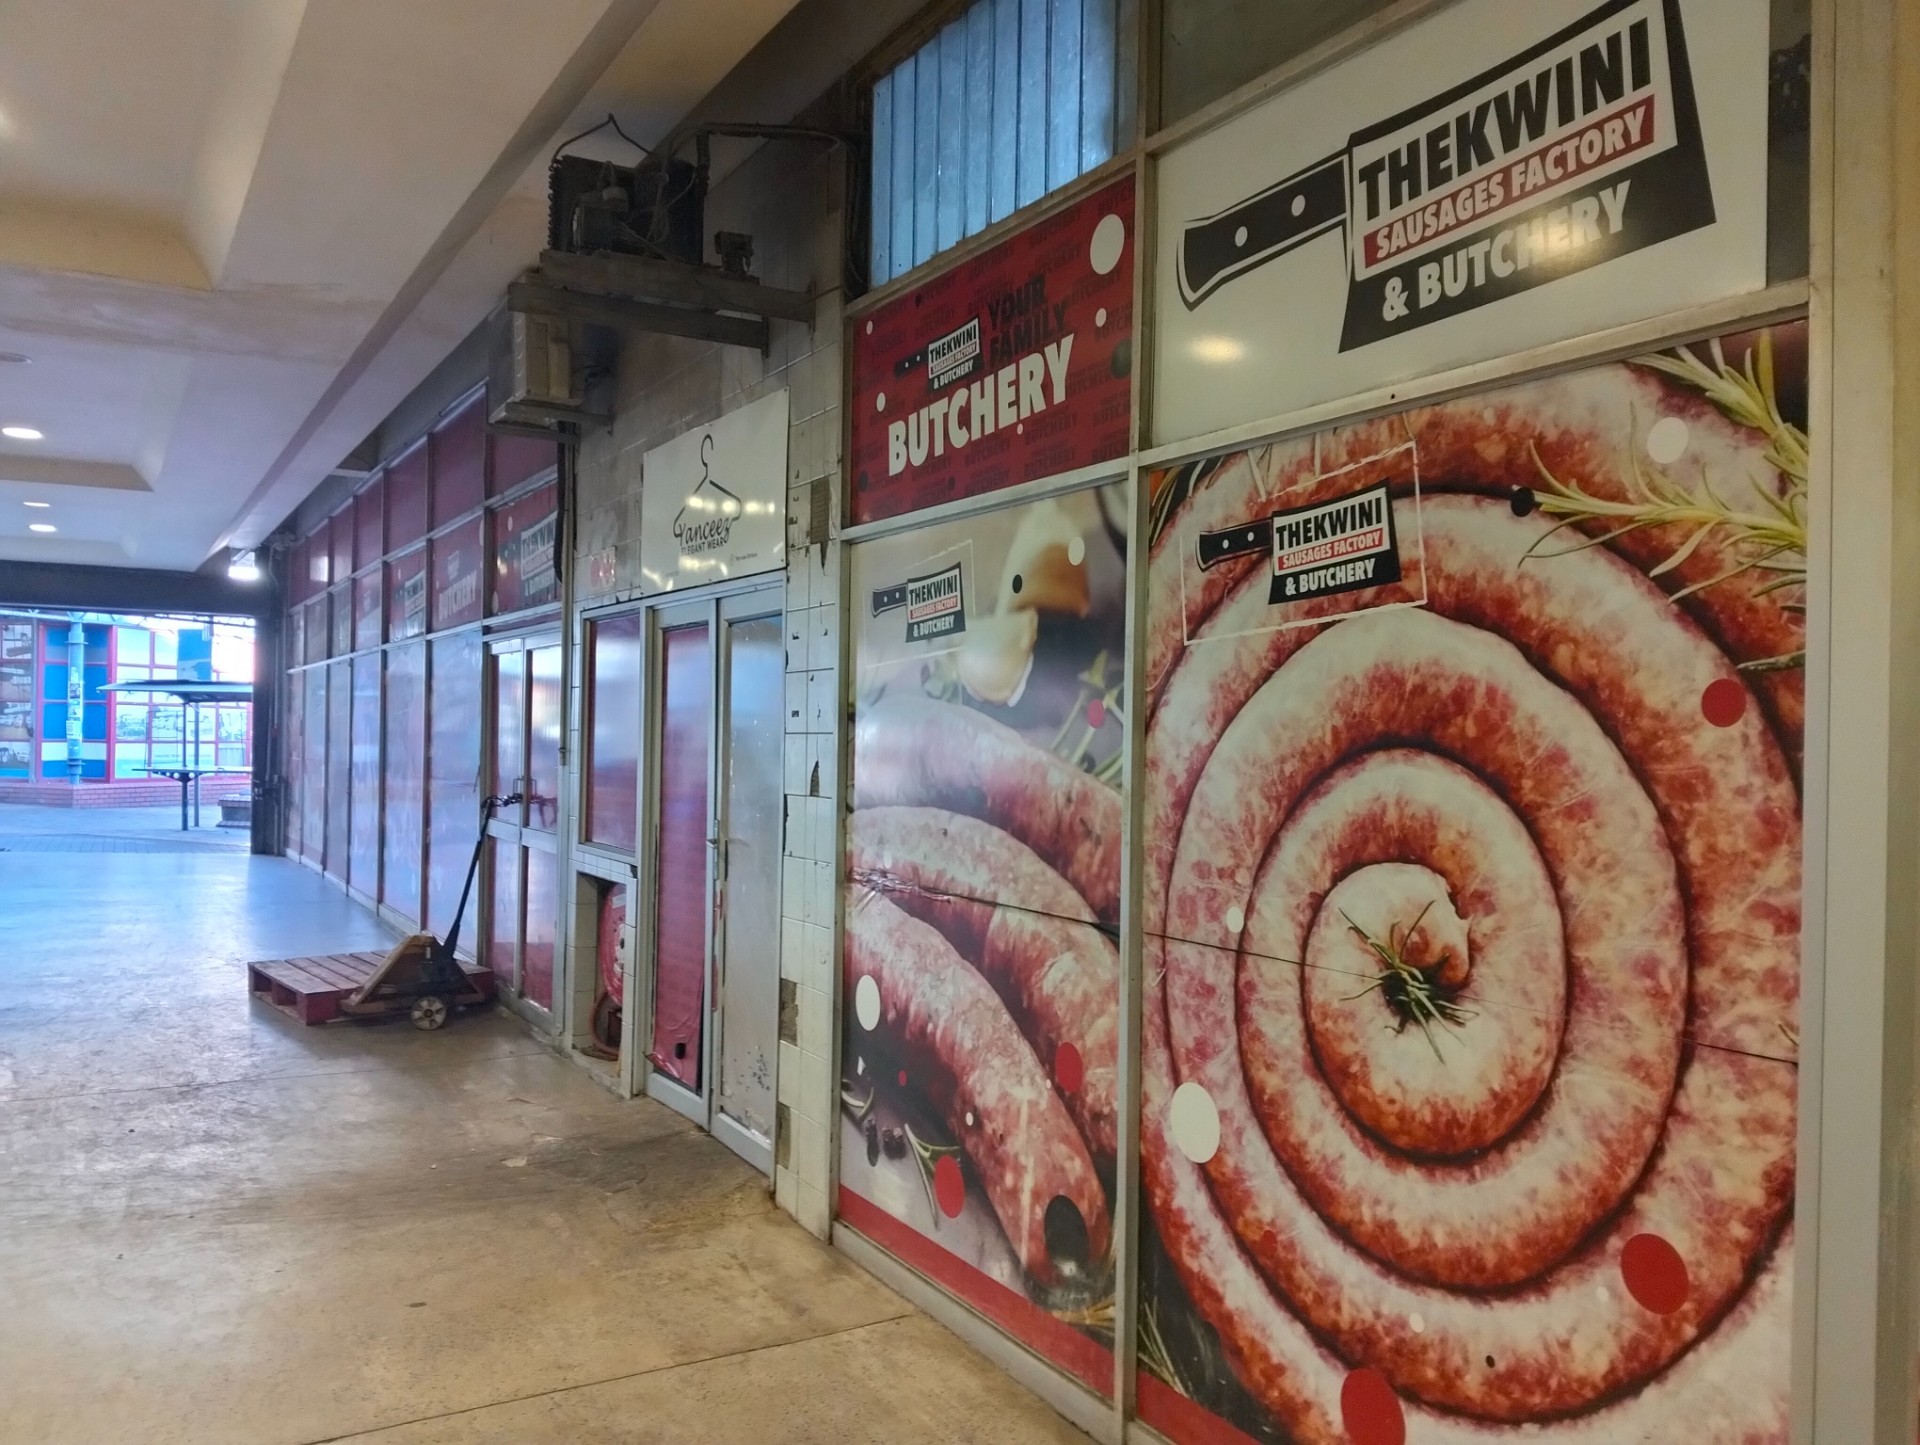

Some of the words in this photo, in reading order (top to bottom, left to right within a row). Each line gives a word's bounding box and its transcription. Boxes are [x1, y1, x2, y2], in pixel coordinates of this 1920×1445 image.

[1359, 17, 1651, 222] THEKWINI
[1375, 172, 1505, 259] SAUSAGES
[1511, 105, 1648, 198] FACTORY
[1381, 276, 1410, 321] &
[1418, 179, 1632, 310] BUTCHERY
[987, 273, 1045, 330] YOUR
[929, 323, 977, 364] THEKWINI
[989, 299, 1070, 366] FAMILY
[940, 359, 974, 385] BUTCHERY
[888, 333, 1075, 477] BUTCHERY
[1276, 497, 1383, 551] THEKWINI
[1283, 544, 1332, 569] SAUSAGES
[1333, 530, 1381, 556] FACTORY
[438, 569, 477, 622] BUTCHERY
[909, 574, 958, 607] THEKWINI
[1285, 576, 1297, 596] &
[1299, 558, 1376, 594] BUTCHERY
[912, 624, 919, 637] &
[919, 615, 955, 635] BUTCHERY
